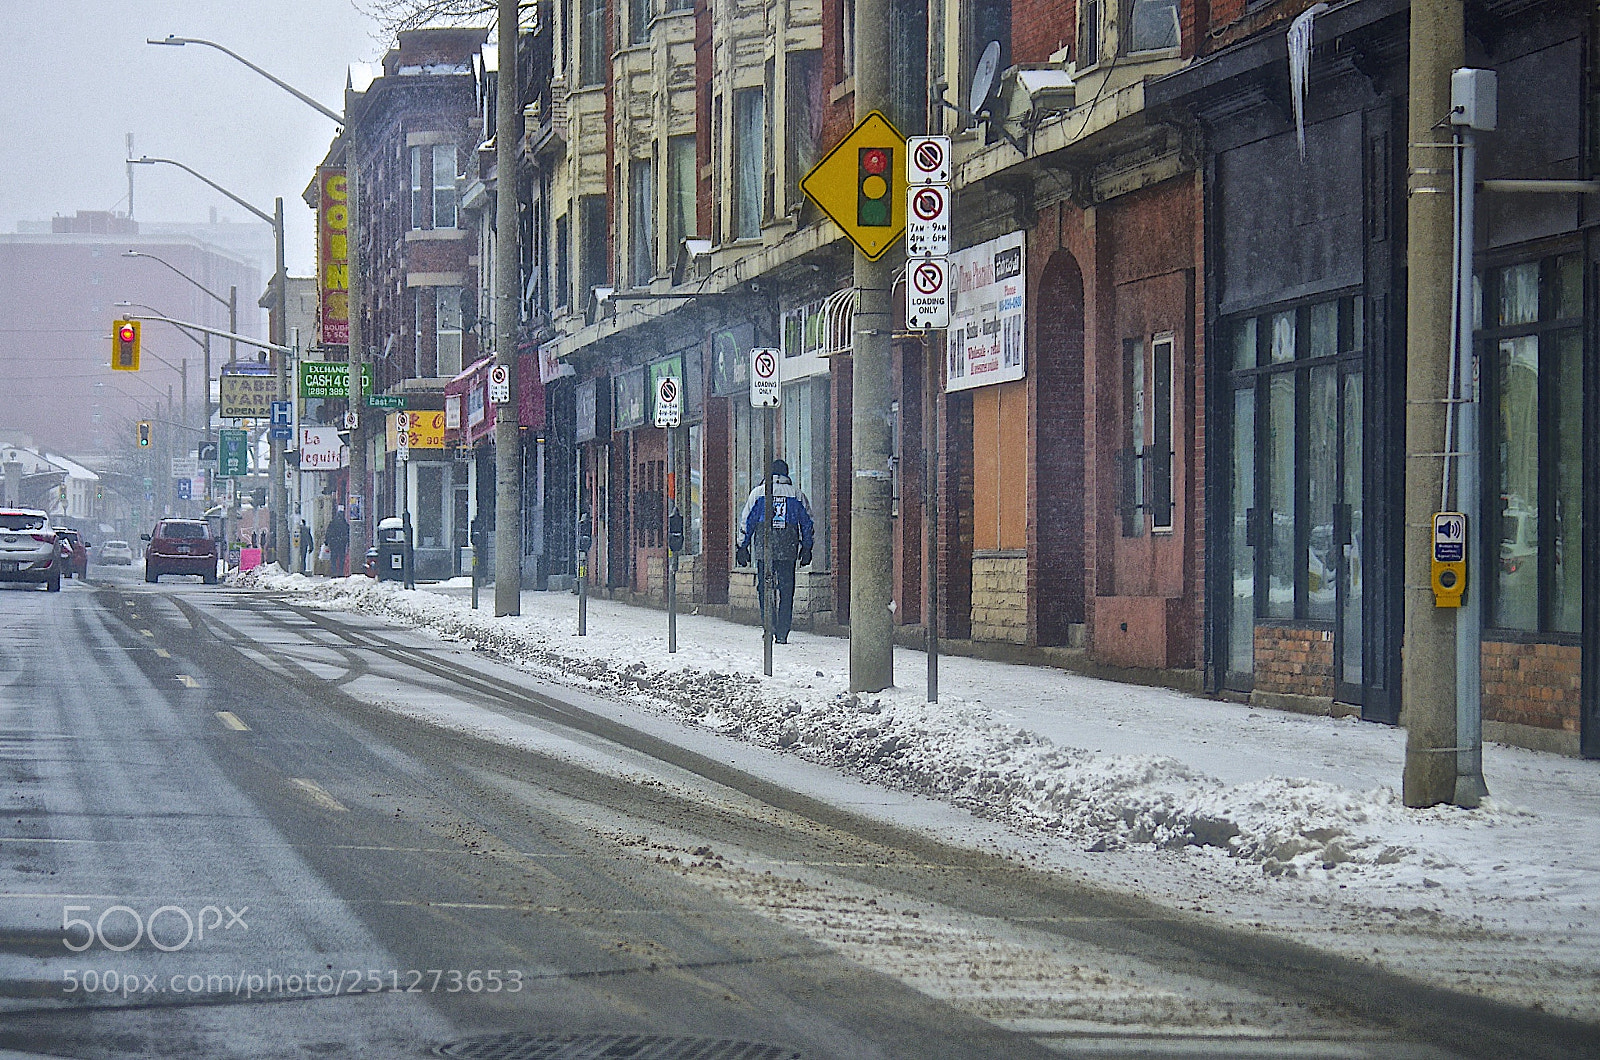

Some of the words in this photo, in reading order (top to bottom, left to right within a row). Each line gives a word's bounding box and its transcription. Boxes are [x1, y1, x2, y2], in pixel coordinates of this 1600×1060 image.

[910, 223, 924, 232] 7AM
[932, 222, 946, 231] 9AM
[910, 233, 925, 242] 4PM
[932, 233, 947, 242] 6PM
[919, 306, 938, 314] ONLY
[309, 366, 350, 374] EXCHANG
[305, 375, 332, 387] CASH
[334, 375, 341, 386] 4
[369, 397, 388, 406] East
[397, 398, 404, 406] N
[225, 407, 256, 415] OPEN
